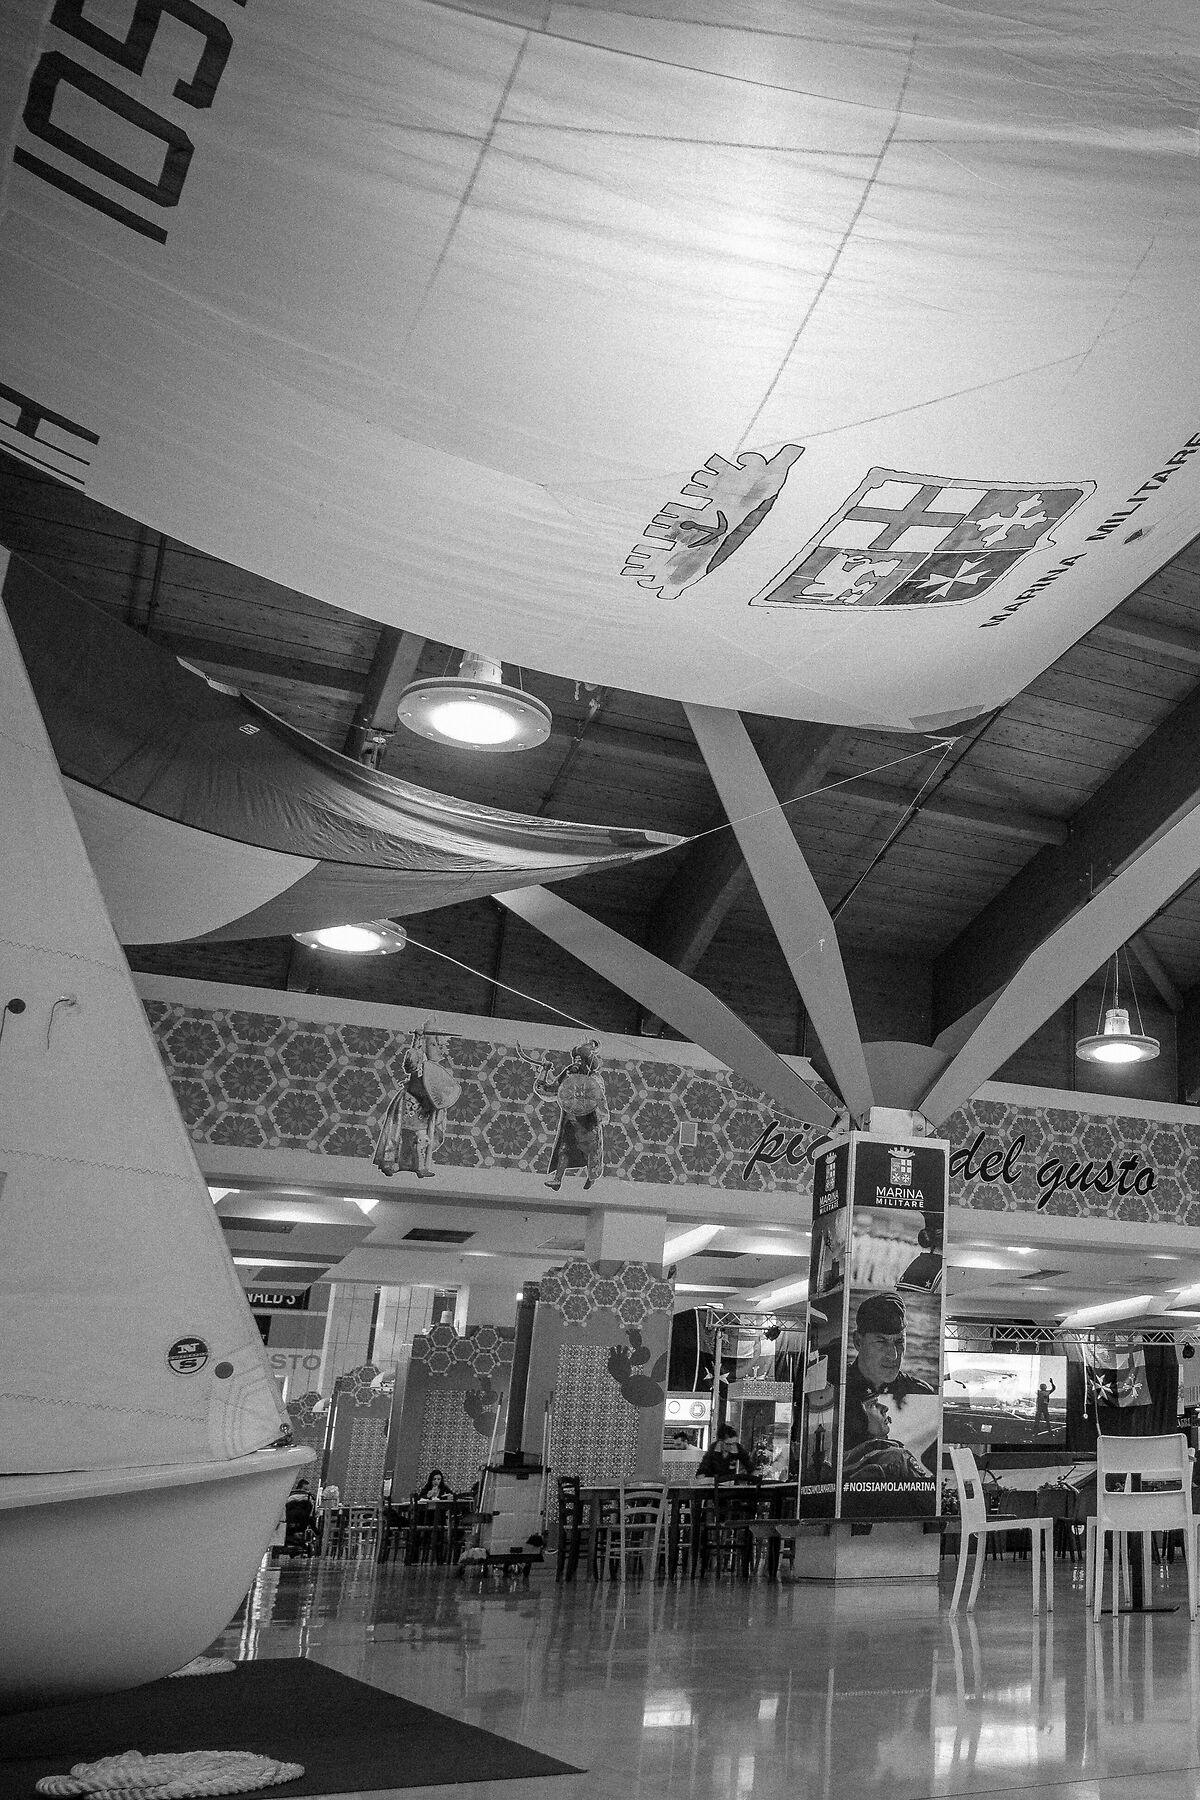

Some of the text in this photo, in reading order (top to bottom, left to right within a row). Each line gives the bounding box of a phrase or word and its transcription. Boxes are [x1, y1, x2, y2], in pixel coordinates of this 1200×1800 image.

[978, 552, 1088, 629] MARINA
[949, 1129, 1026, 1186] del
[1036, 1153, 1159, 1211] gusto
[876, 1186, 924, 1200] MARINA
[875, 1197, 924, 1208] MILITARE
[843, 1482, 936, 1492] #NOISIAMOLAMARINA
